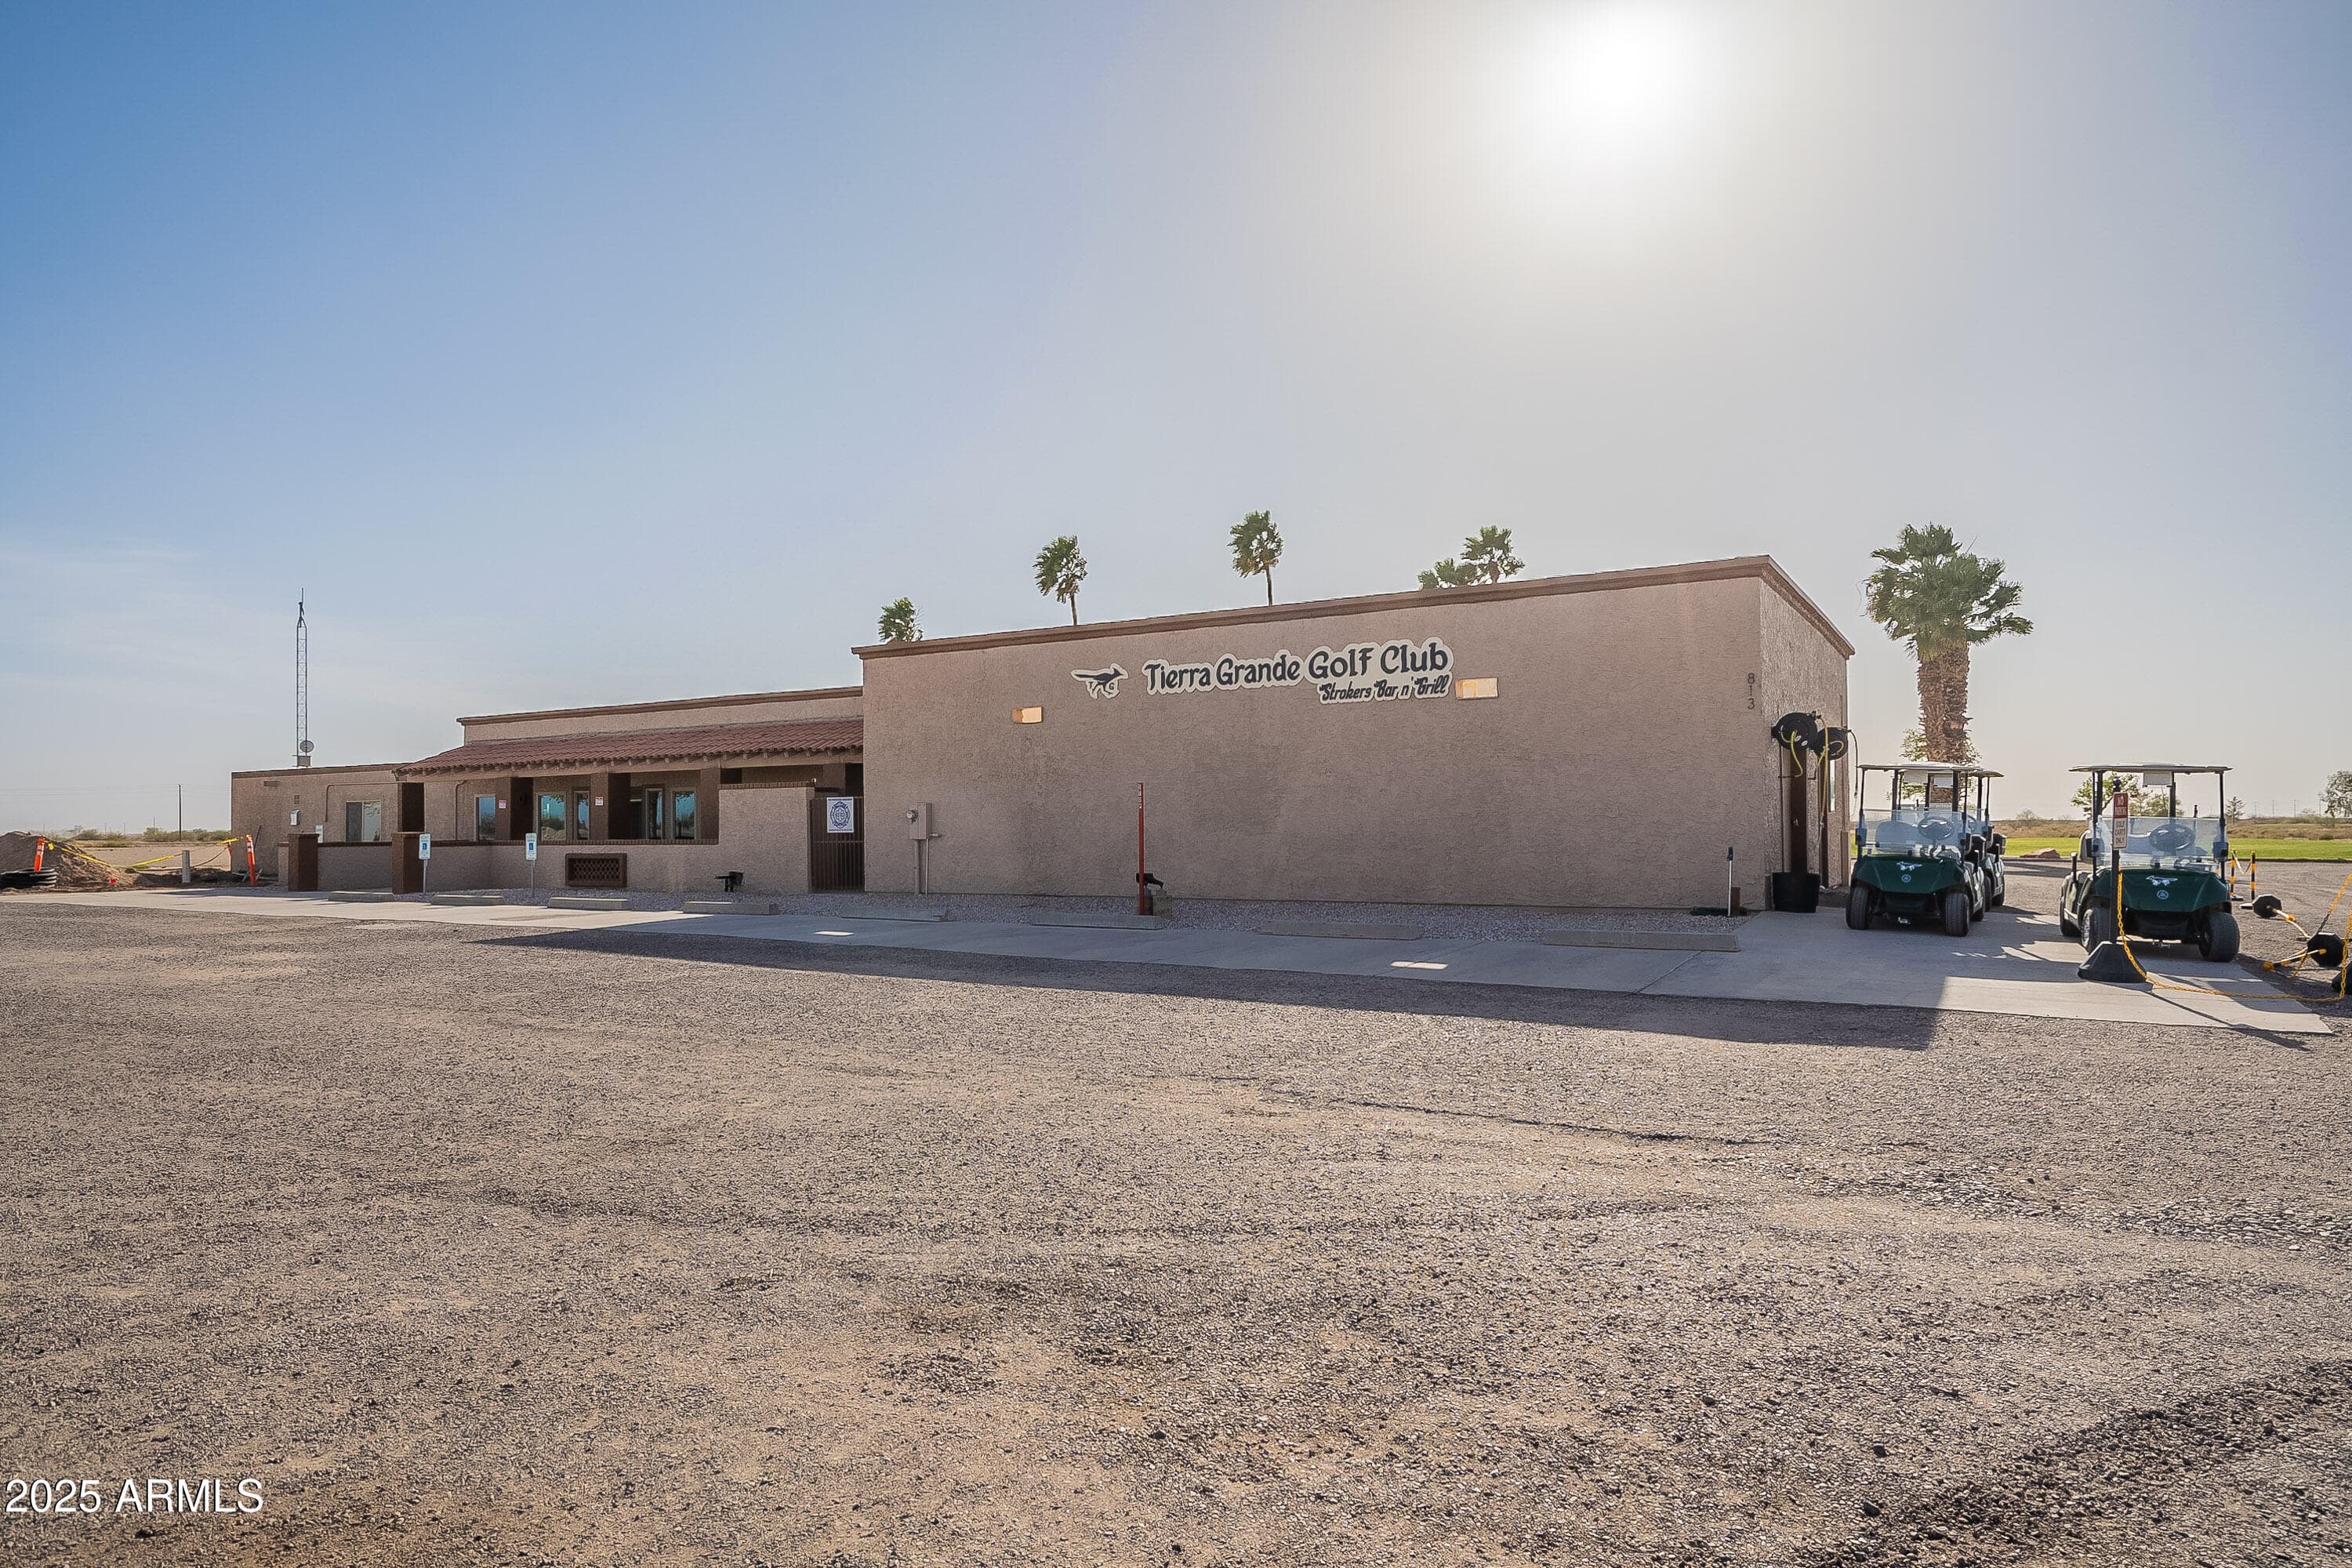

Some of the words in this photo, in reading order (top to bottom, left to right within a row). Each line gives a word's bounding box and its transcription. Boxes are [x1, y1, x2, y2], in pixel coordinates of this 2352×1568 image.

[1144, 662, 1210, 691] Tierra
[1216, 654, 1301, 686] Grande
[1308, 647, 1374, 680] Golf
[1380, 642, 1448, 674] Club
[1319, 681, 1372, 702] Strokers
[1374, 679, 1399, 698] Bar
